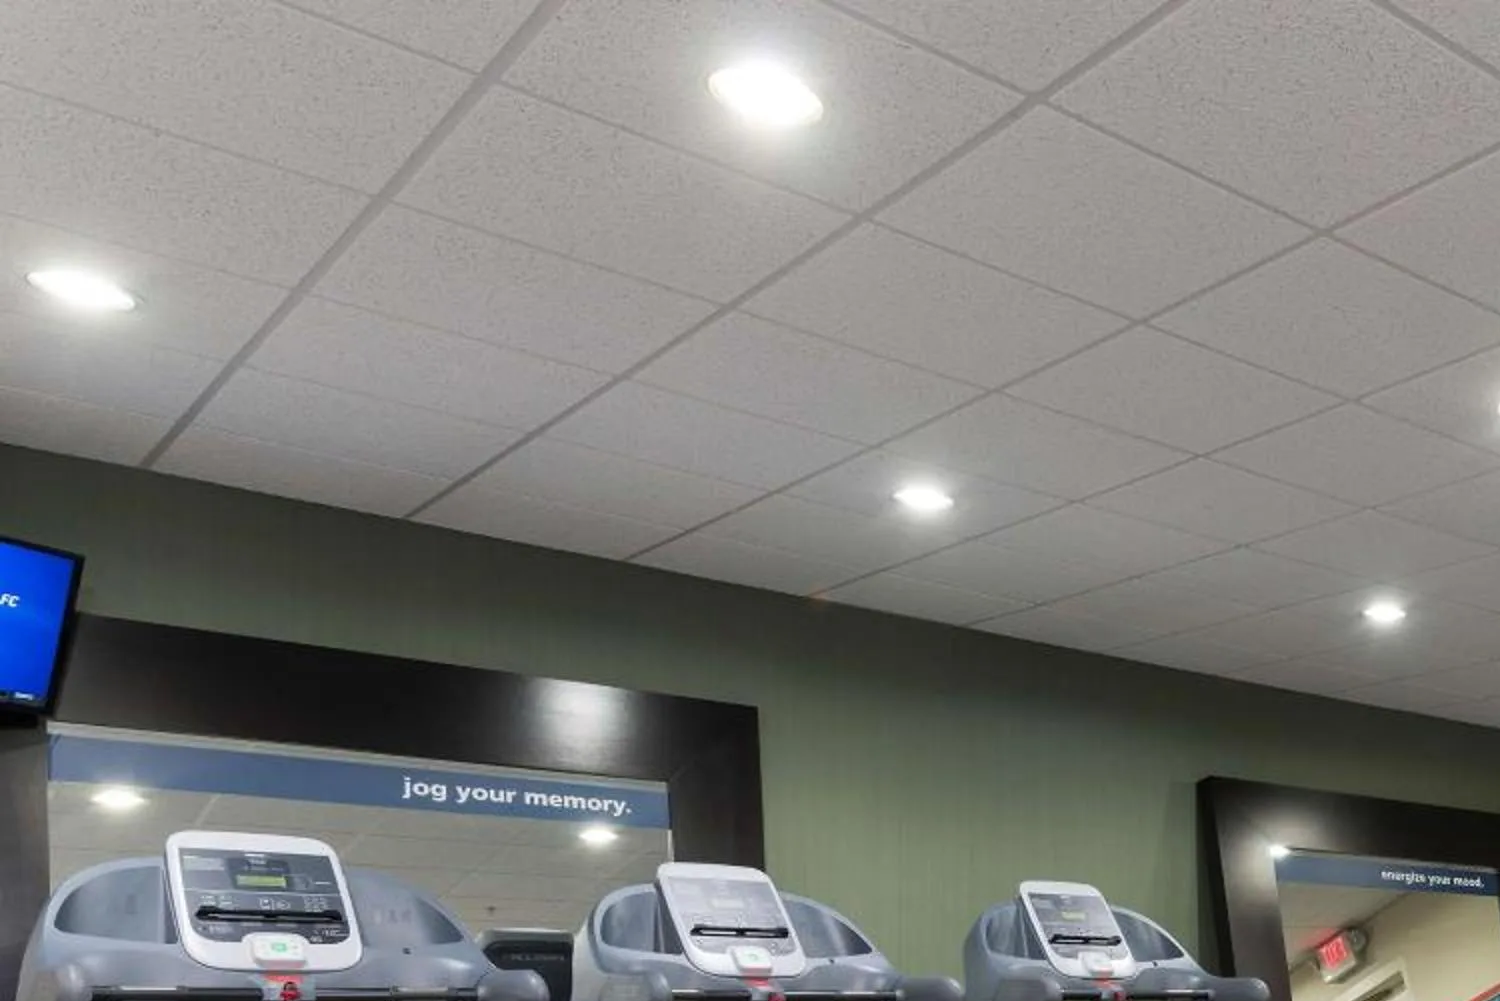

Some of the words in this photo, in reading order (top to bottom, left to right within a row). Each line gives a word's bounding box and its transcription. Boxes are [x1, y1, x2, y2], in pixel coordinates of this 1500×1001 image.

[402, 777, 447, 801] jog
[455, 784, 517, 804] your
[523, 789, 633, 817] memory.
[1381, 871, 1426, 885] energize
[1427, 874, 1451, 887] your
[1453, 875, 1485, 888] mood.
